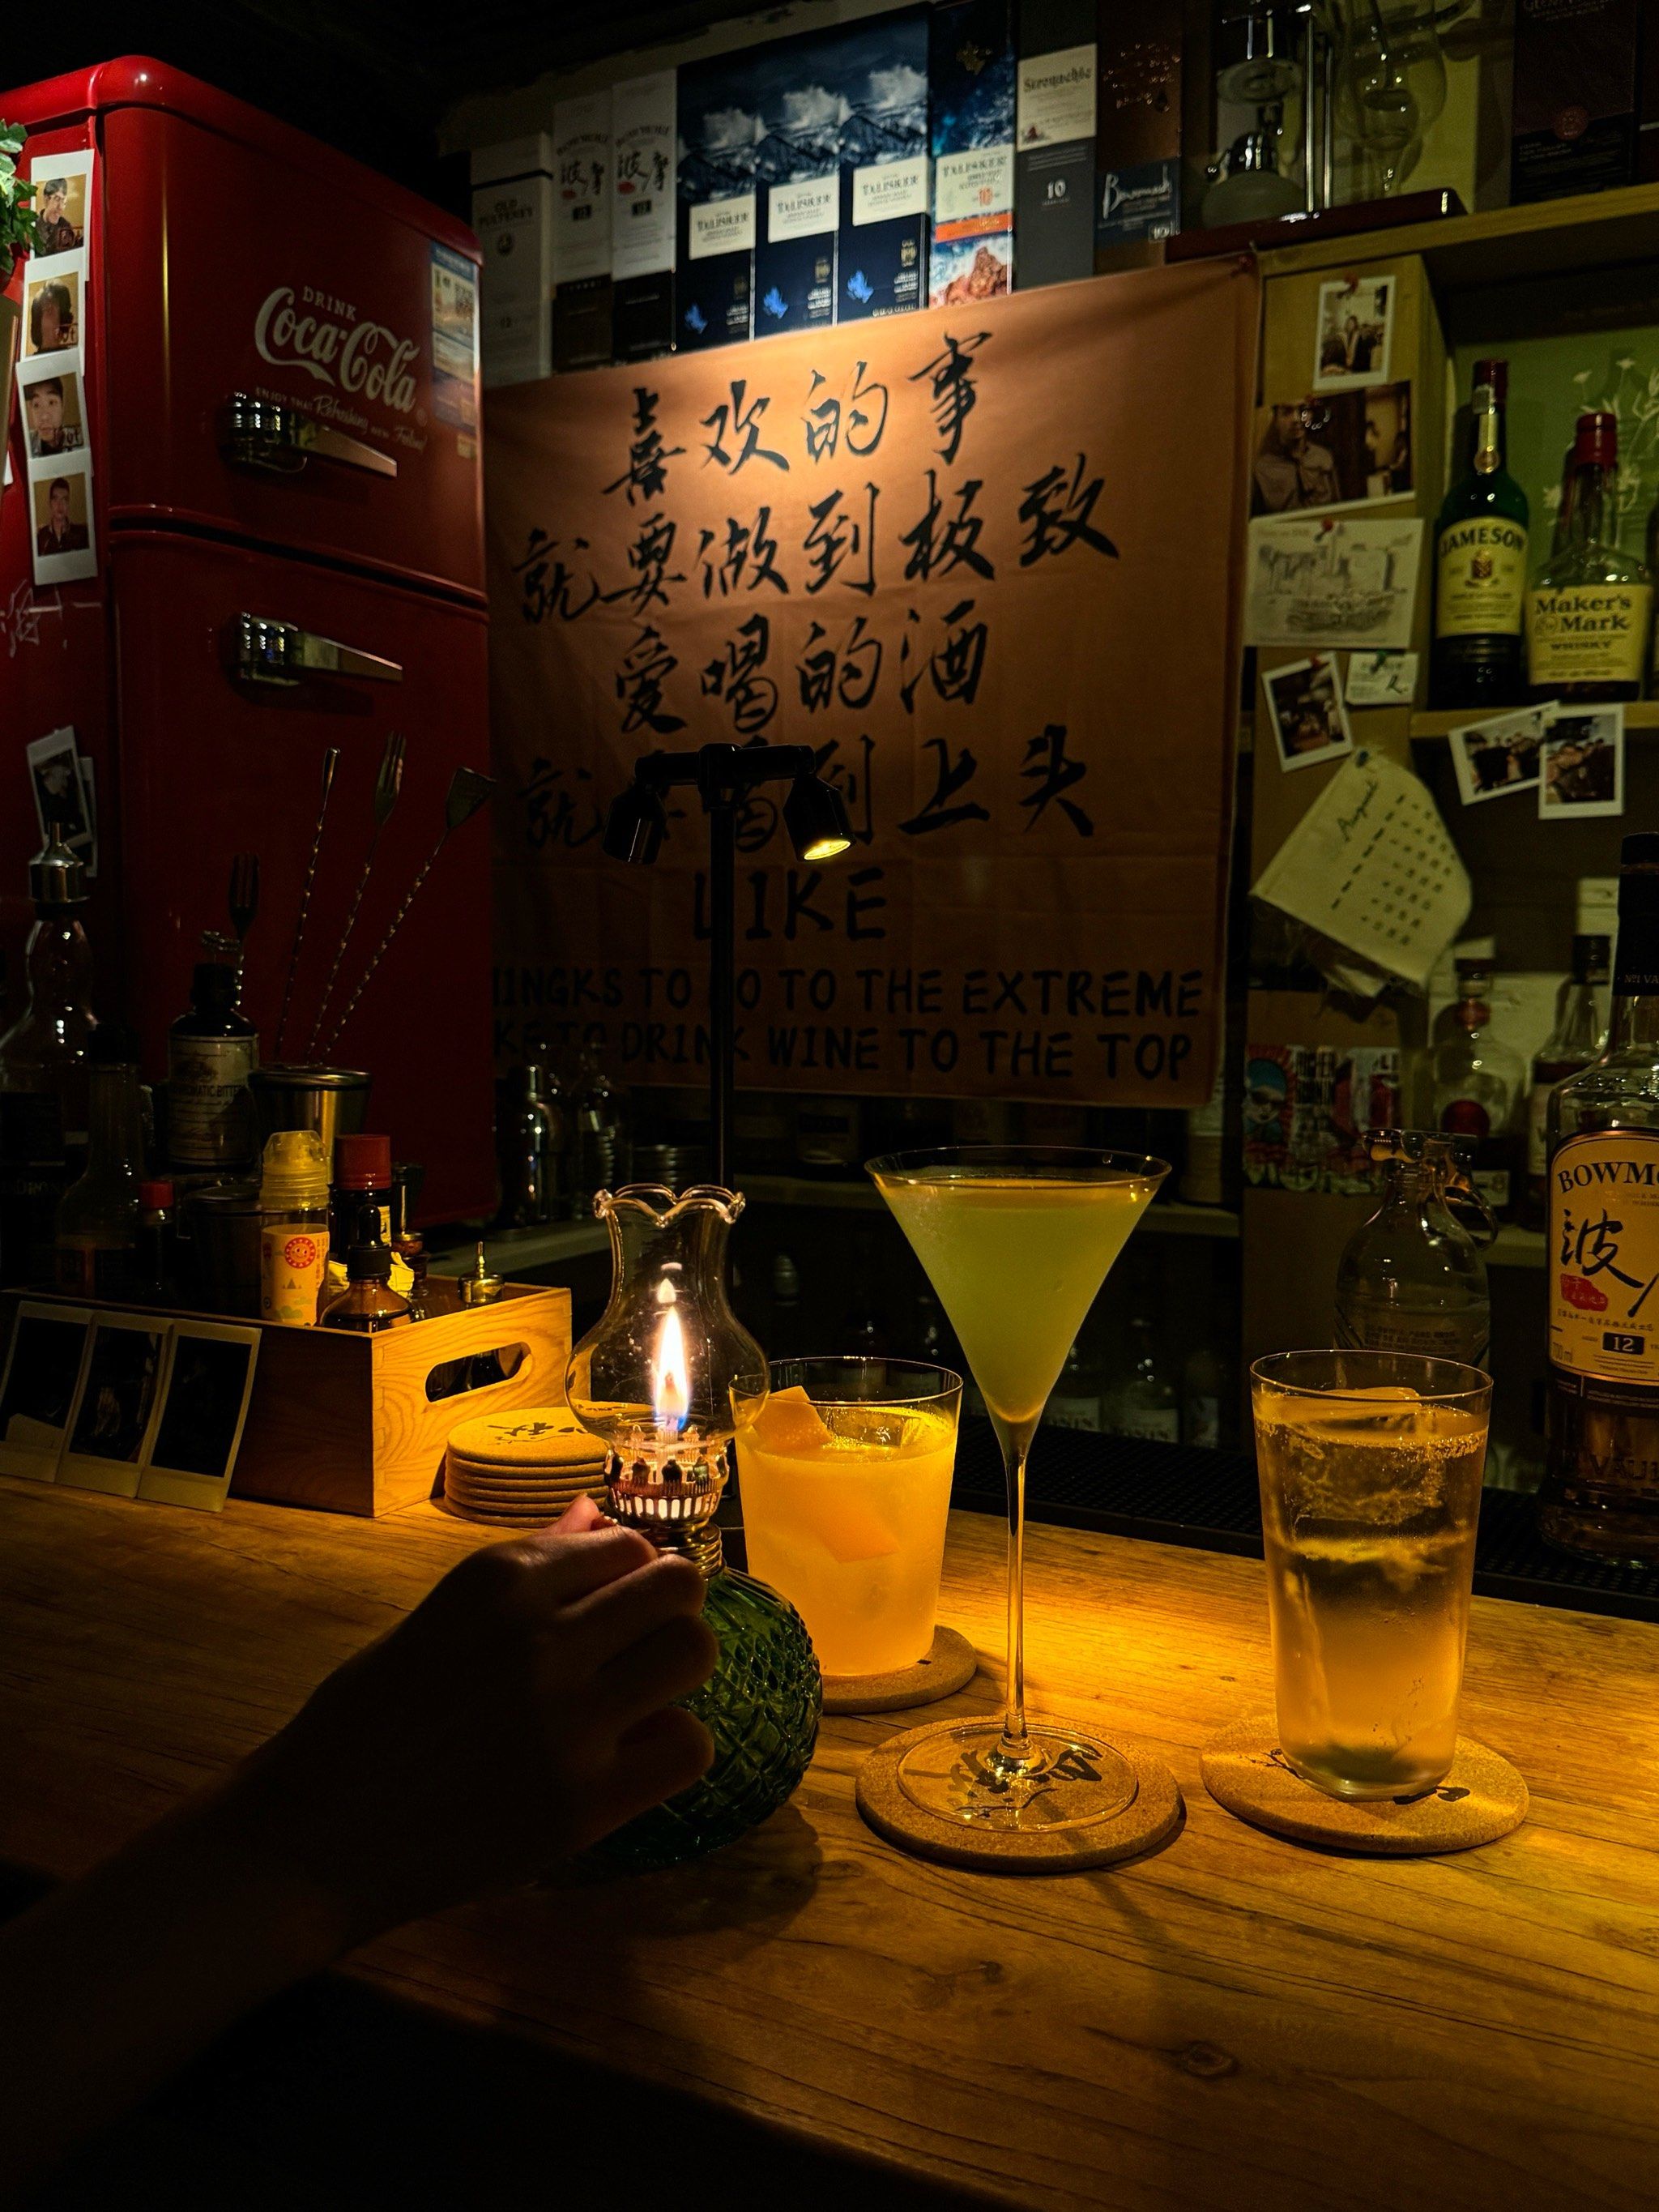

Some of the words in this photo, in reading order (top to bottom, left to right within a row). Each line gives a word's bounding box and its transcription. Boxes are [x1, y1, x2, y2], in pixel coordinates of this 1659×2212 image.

[1047, 178, 1066, 199] 10
[301, 284, 357, 322] DRINK
[254, 286, 421, 414] Coca-Cola
[603, 332, 993, 506] 喜欢的事
[1439, 525, 1525, 557] JAMESON
[1536, 593, 1631, 614] Maker's
[1560, 614, 1630, 632] Mark
[518, 724, 1094, 852] 就到上头
[694, 869, 886, 942] LIKE
[492, 966, 624, 1009] INGKS
[642, 967, 692, 1010] TO
[779, 968, 837, 1010] TO
[858, 967, 943, 1014] THE
[962, 968, 1204, 1018] EXTREME
[767, 1025, 880, 1070] WINE
[898, 1027, 959, 1073] TO
[979, 1031, 1073, 1078] THE
[1097, 1033, 1193, 1081] TOP
[1558, 1160, 1659, 1194] BOWM
[1613, 1335, 1635, 1352] 12
